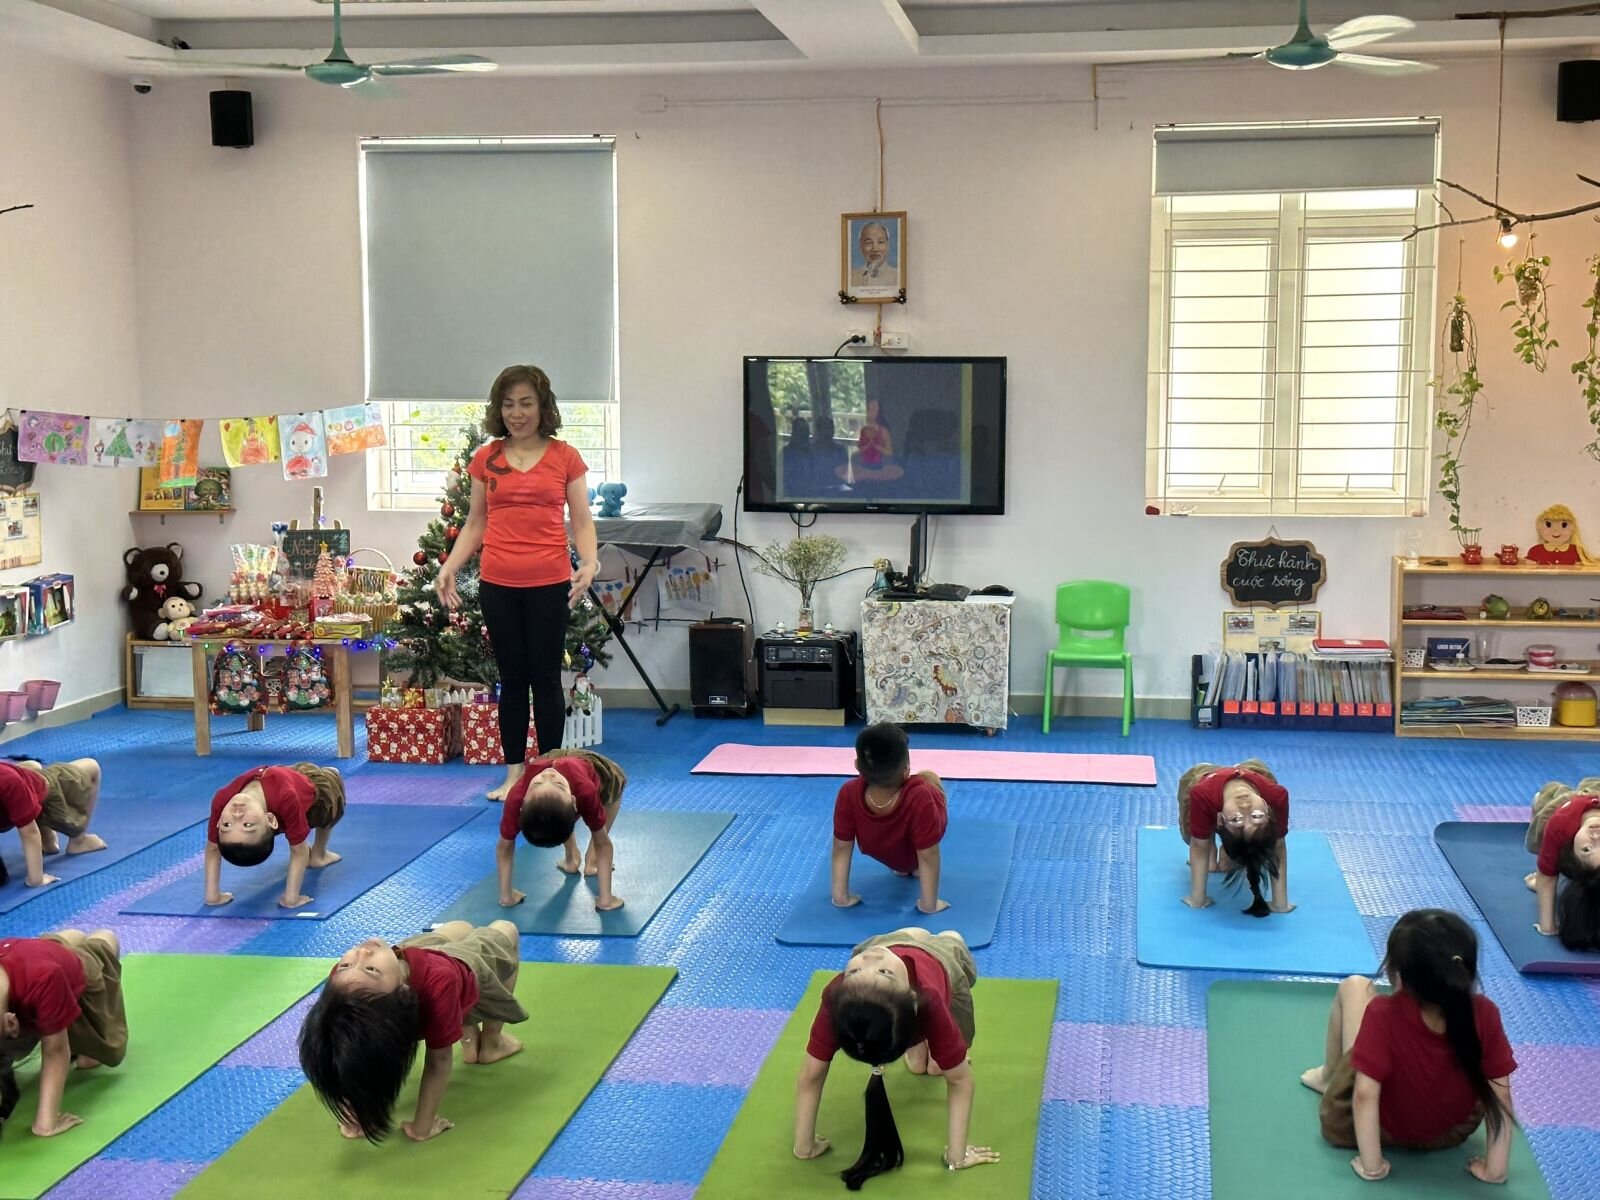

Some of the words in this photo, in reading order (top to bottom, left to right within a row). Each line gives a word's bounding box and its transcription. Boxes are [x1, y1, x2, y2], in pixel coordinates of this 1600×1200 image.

[1304, 705, 1311, 713] 5
[1322, 705, 1329, 713] 4
[1343, 705, 1350, 713] 3
[1361, 705, 1369, 714] 2
[1380, 705, 1387, 714] 1
